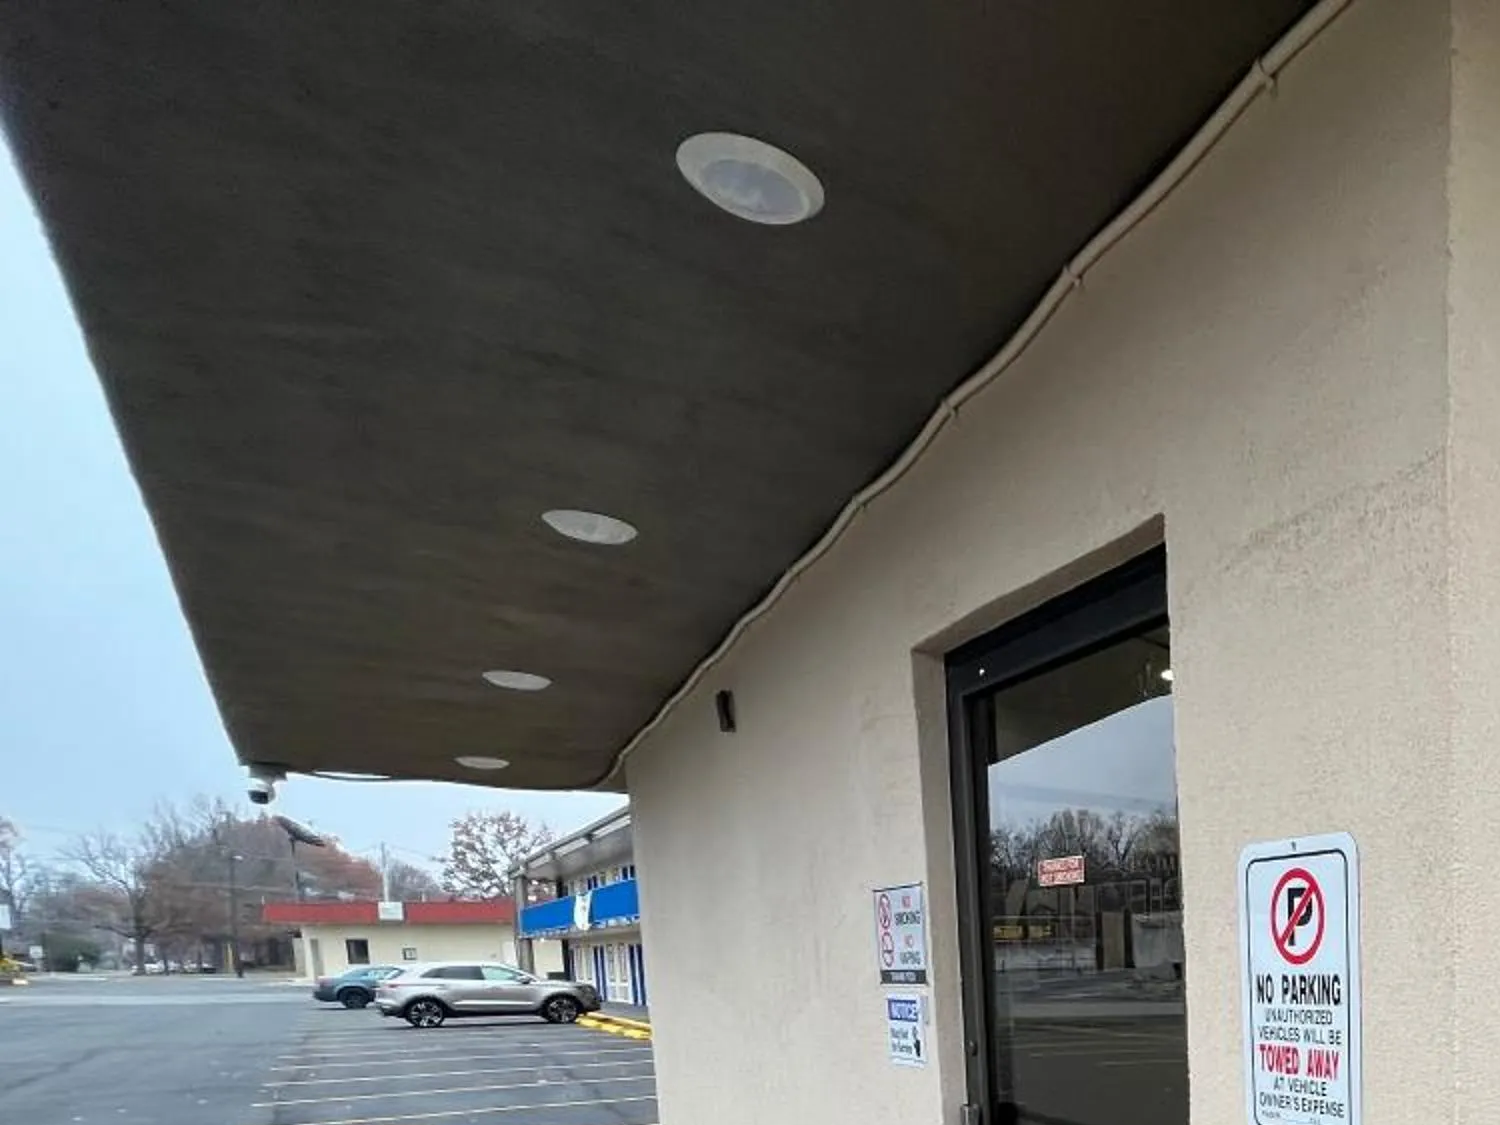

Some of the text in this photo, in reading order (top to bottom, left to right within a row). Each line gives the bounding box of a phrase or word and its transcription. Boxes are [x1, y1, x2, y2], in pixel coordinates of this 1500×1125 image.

[1256, 974, 1341, 1005] NO PARKING
[1265, 1007, 1333, 1025] UNAUTHORIZED
[1259, 1025, 1342, 1045] VEHICLES WILL BE
[1259, 1043, 1339, 1080] TOWED AWAY
[1273, 1075, 1327, 1097] AT VEHICLE
[1260, 1092, 1300, 1111] OWNER'S
[1301, 1098, 1344, 1119] EXPENSE
